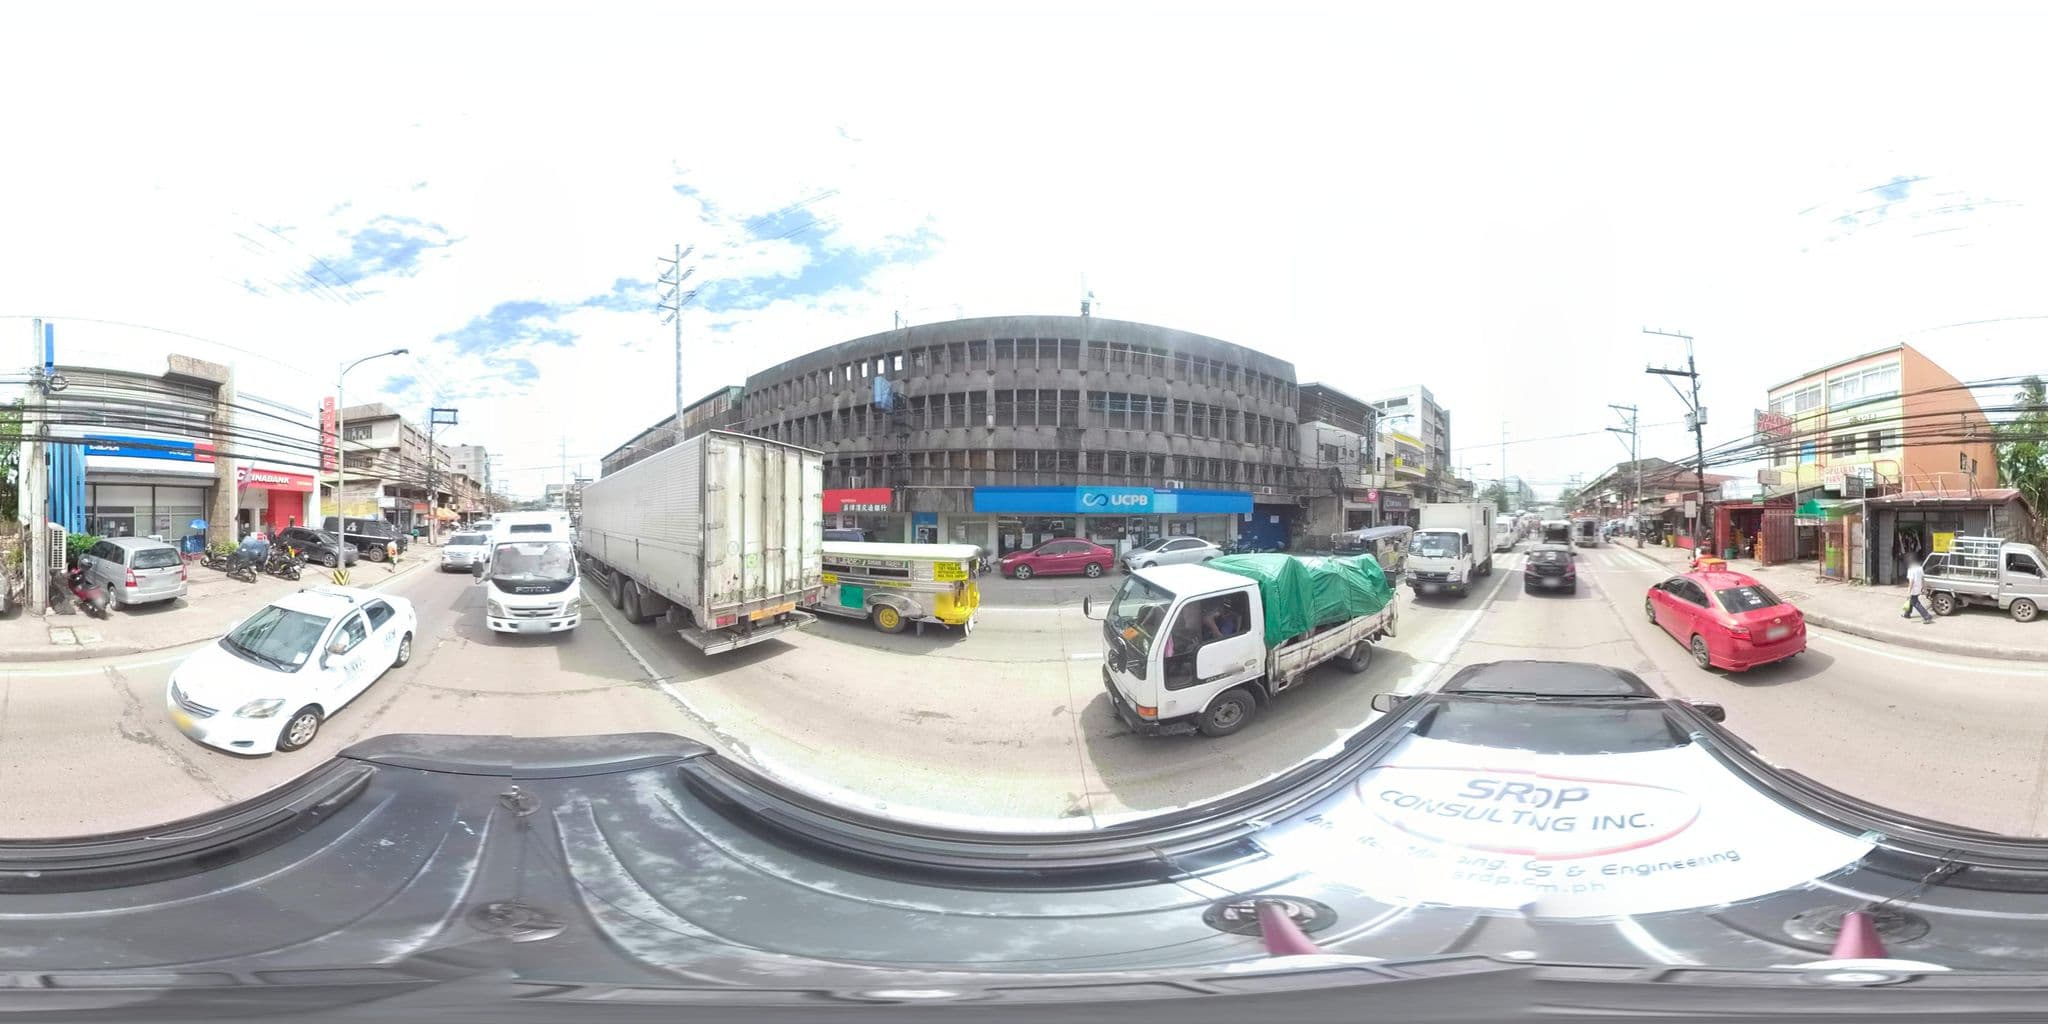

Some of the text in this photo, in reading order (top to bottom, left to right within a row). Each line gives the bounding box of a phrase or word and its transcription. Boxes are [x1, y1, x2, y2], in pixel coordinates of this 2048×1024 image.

[1110, 494, 1148, 506] UCPB
[1592, 813, 1654, 831] INC.
[1601, 849, 1740, 877] Engineering
